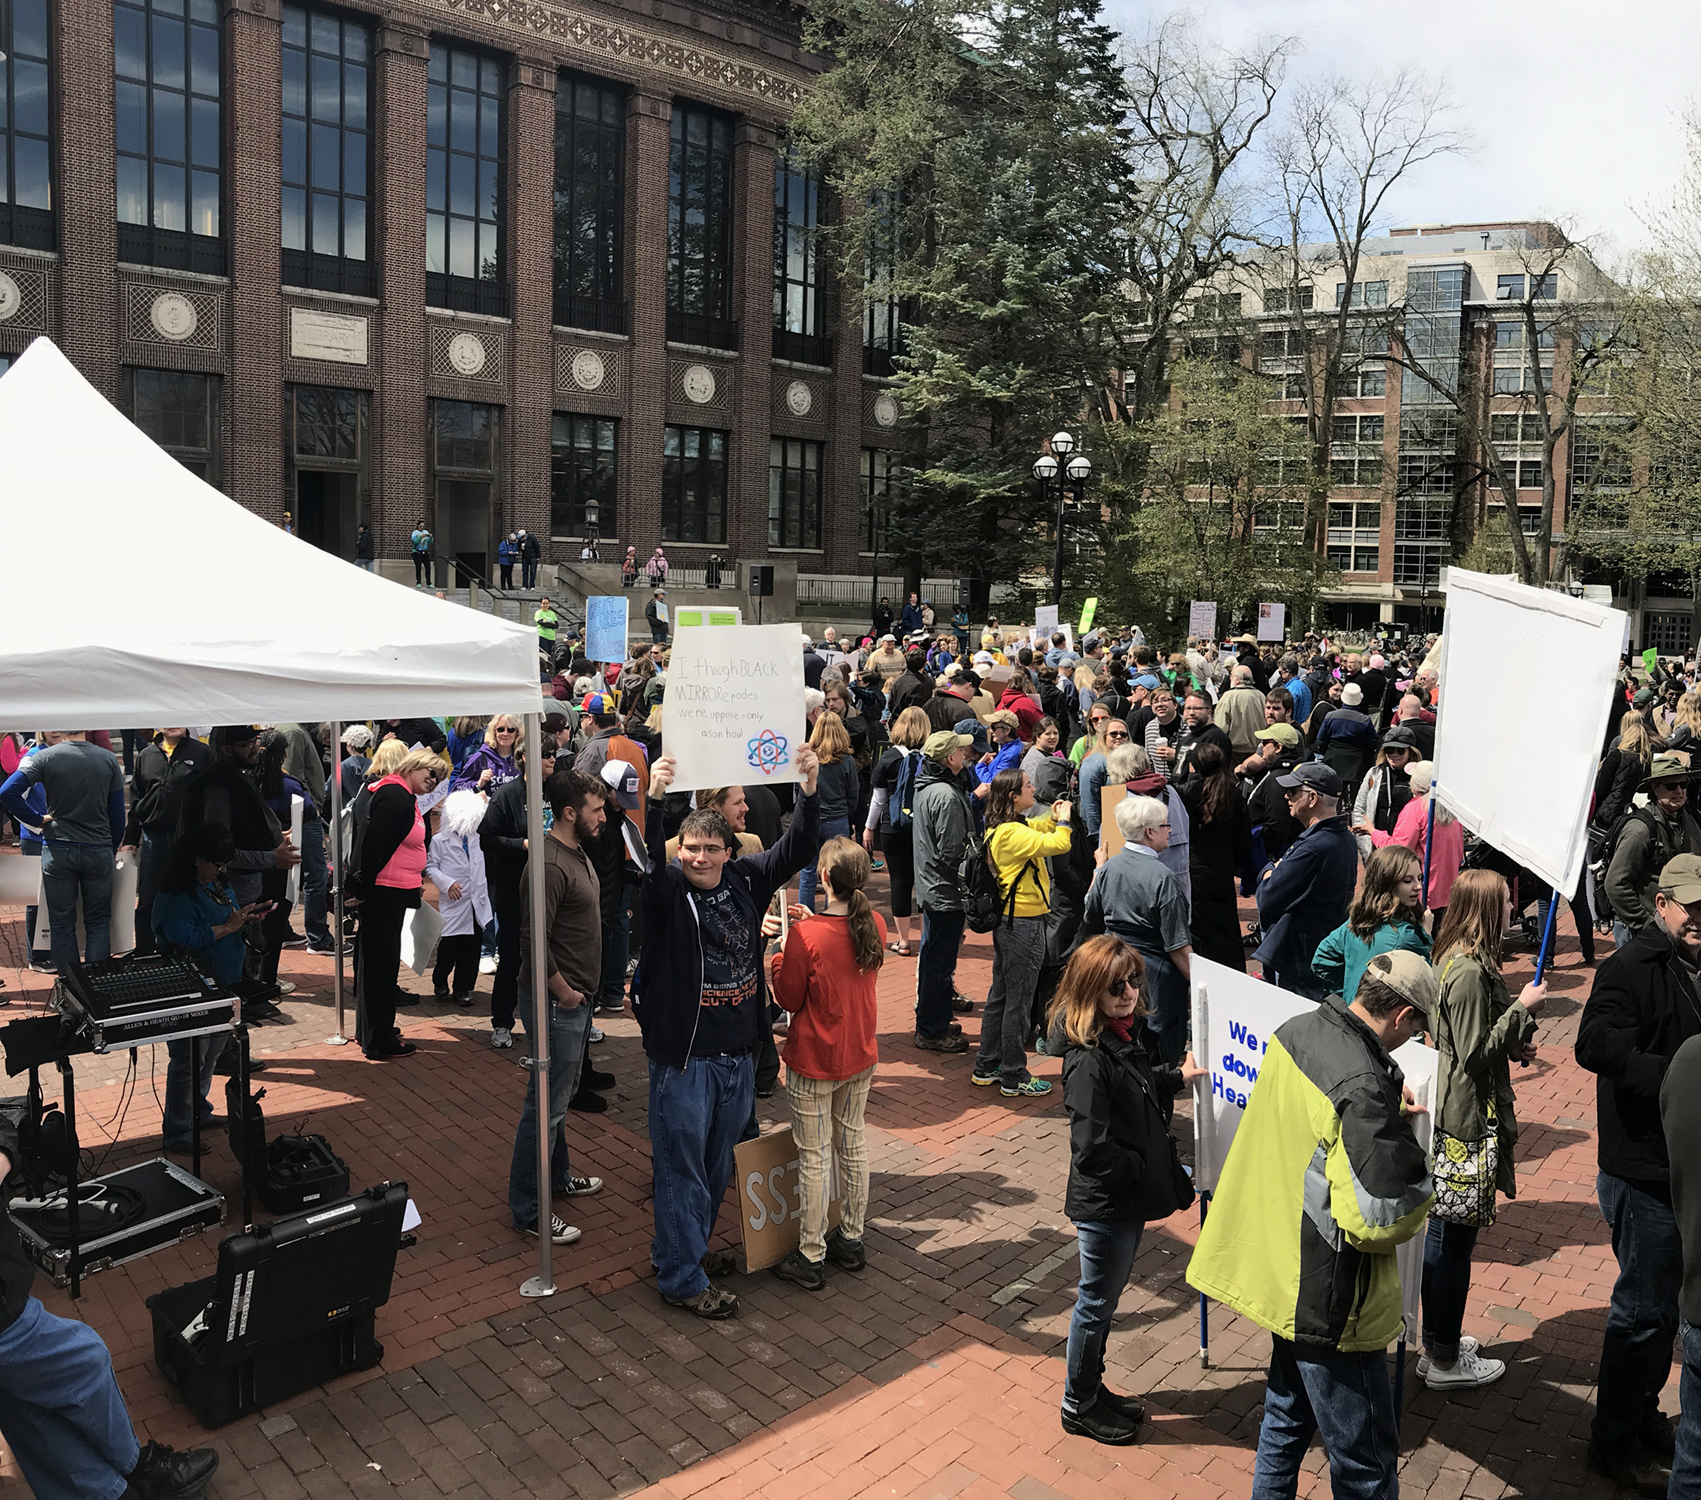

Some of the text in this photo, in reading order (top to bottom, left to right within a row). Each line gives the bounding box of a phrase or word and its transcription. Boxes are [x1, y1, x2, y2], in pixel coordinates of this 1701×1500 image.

[308, 328, 351, 344] LIBRARY
[676, 656, 690, 680] I
[123, 1020, 143, 1030] ALLEN
[144, 1019, 150, 1027] &
[150, 1016, 170, 1026] HEATH
[190, 1009, 209, 1018] MIXER
[1228, 1019, 1259, 1052] We
[1212, 1071, 1251, 1111] Hea
